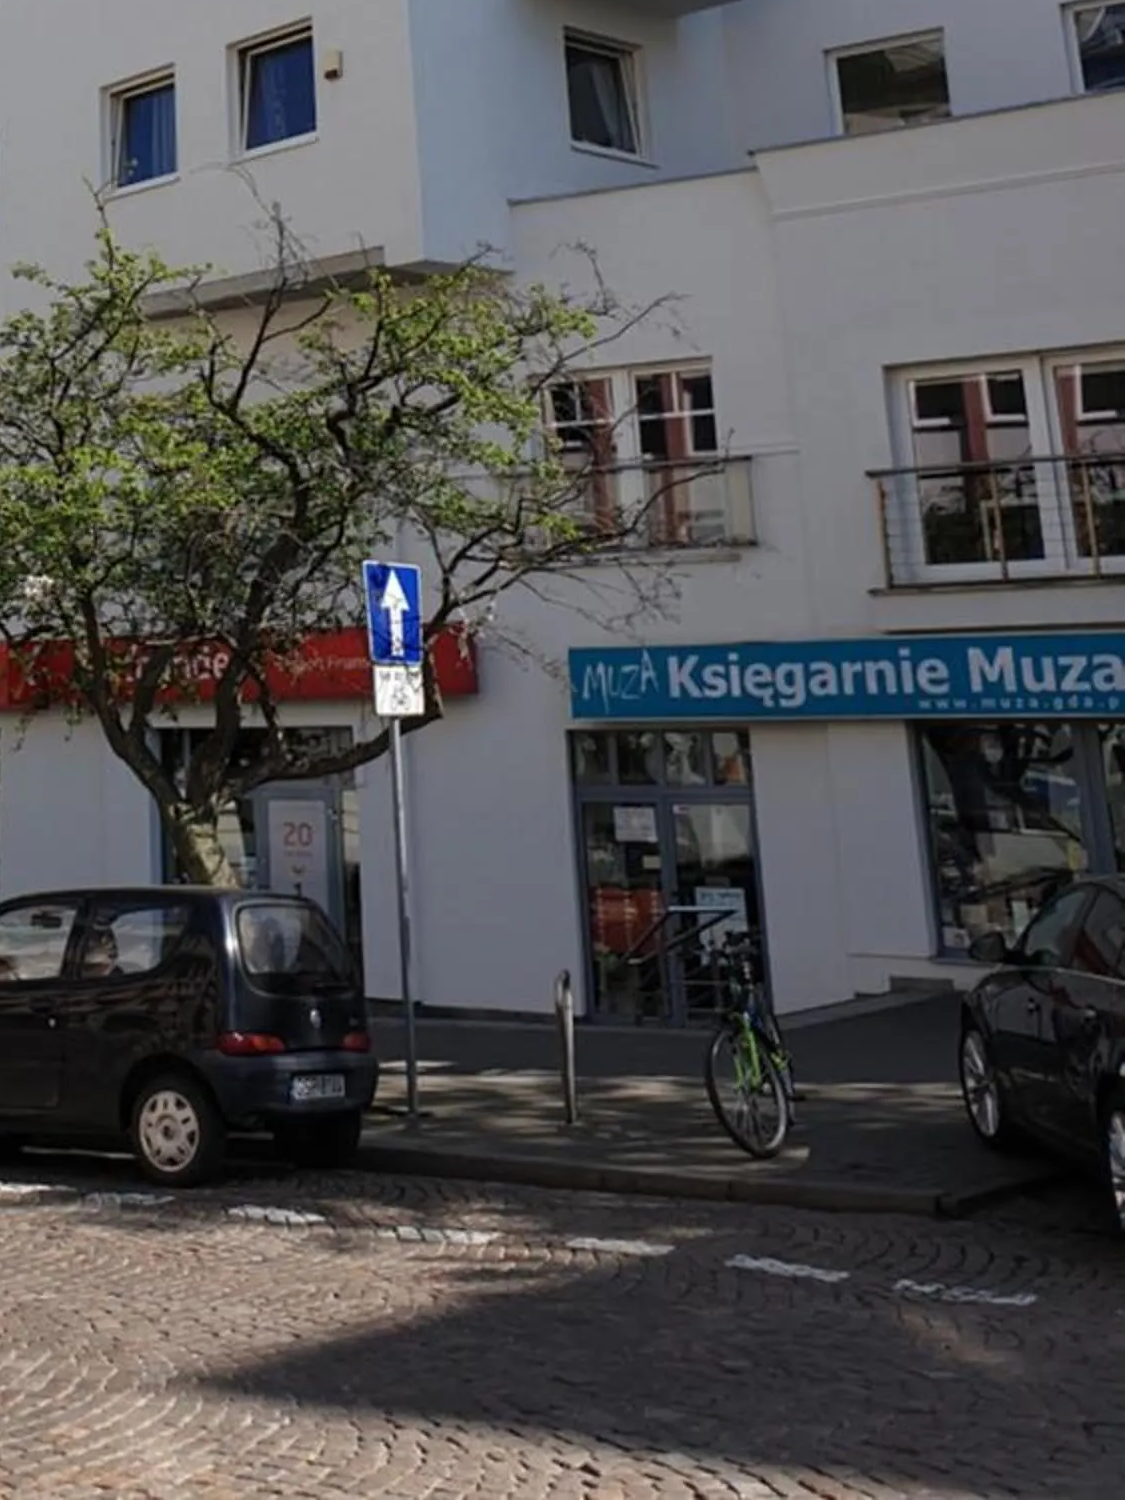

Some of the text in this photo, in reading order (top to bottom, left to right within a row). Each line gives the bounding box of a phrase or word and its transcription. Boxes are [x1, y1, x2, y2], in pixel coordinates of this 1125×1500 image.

[582, 649, 659, 714] MUZA
[667, 646, 1125, 707] Księgarnie Muza
[282, 821, 313, 848] 20
